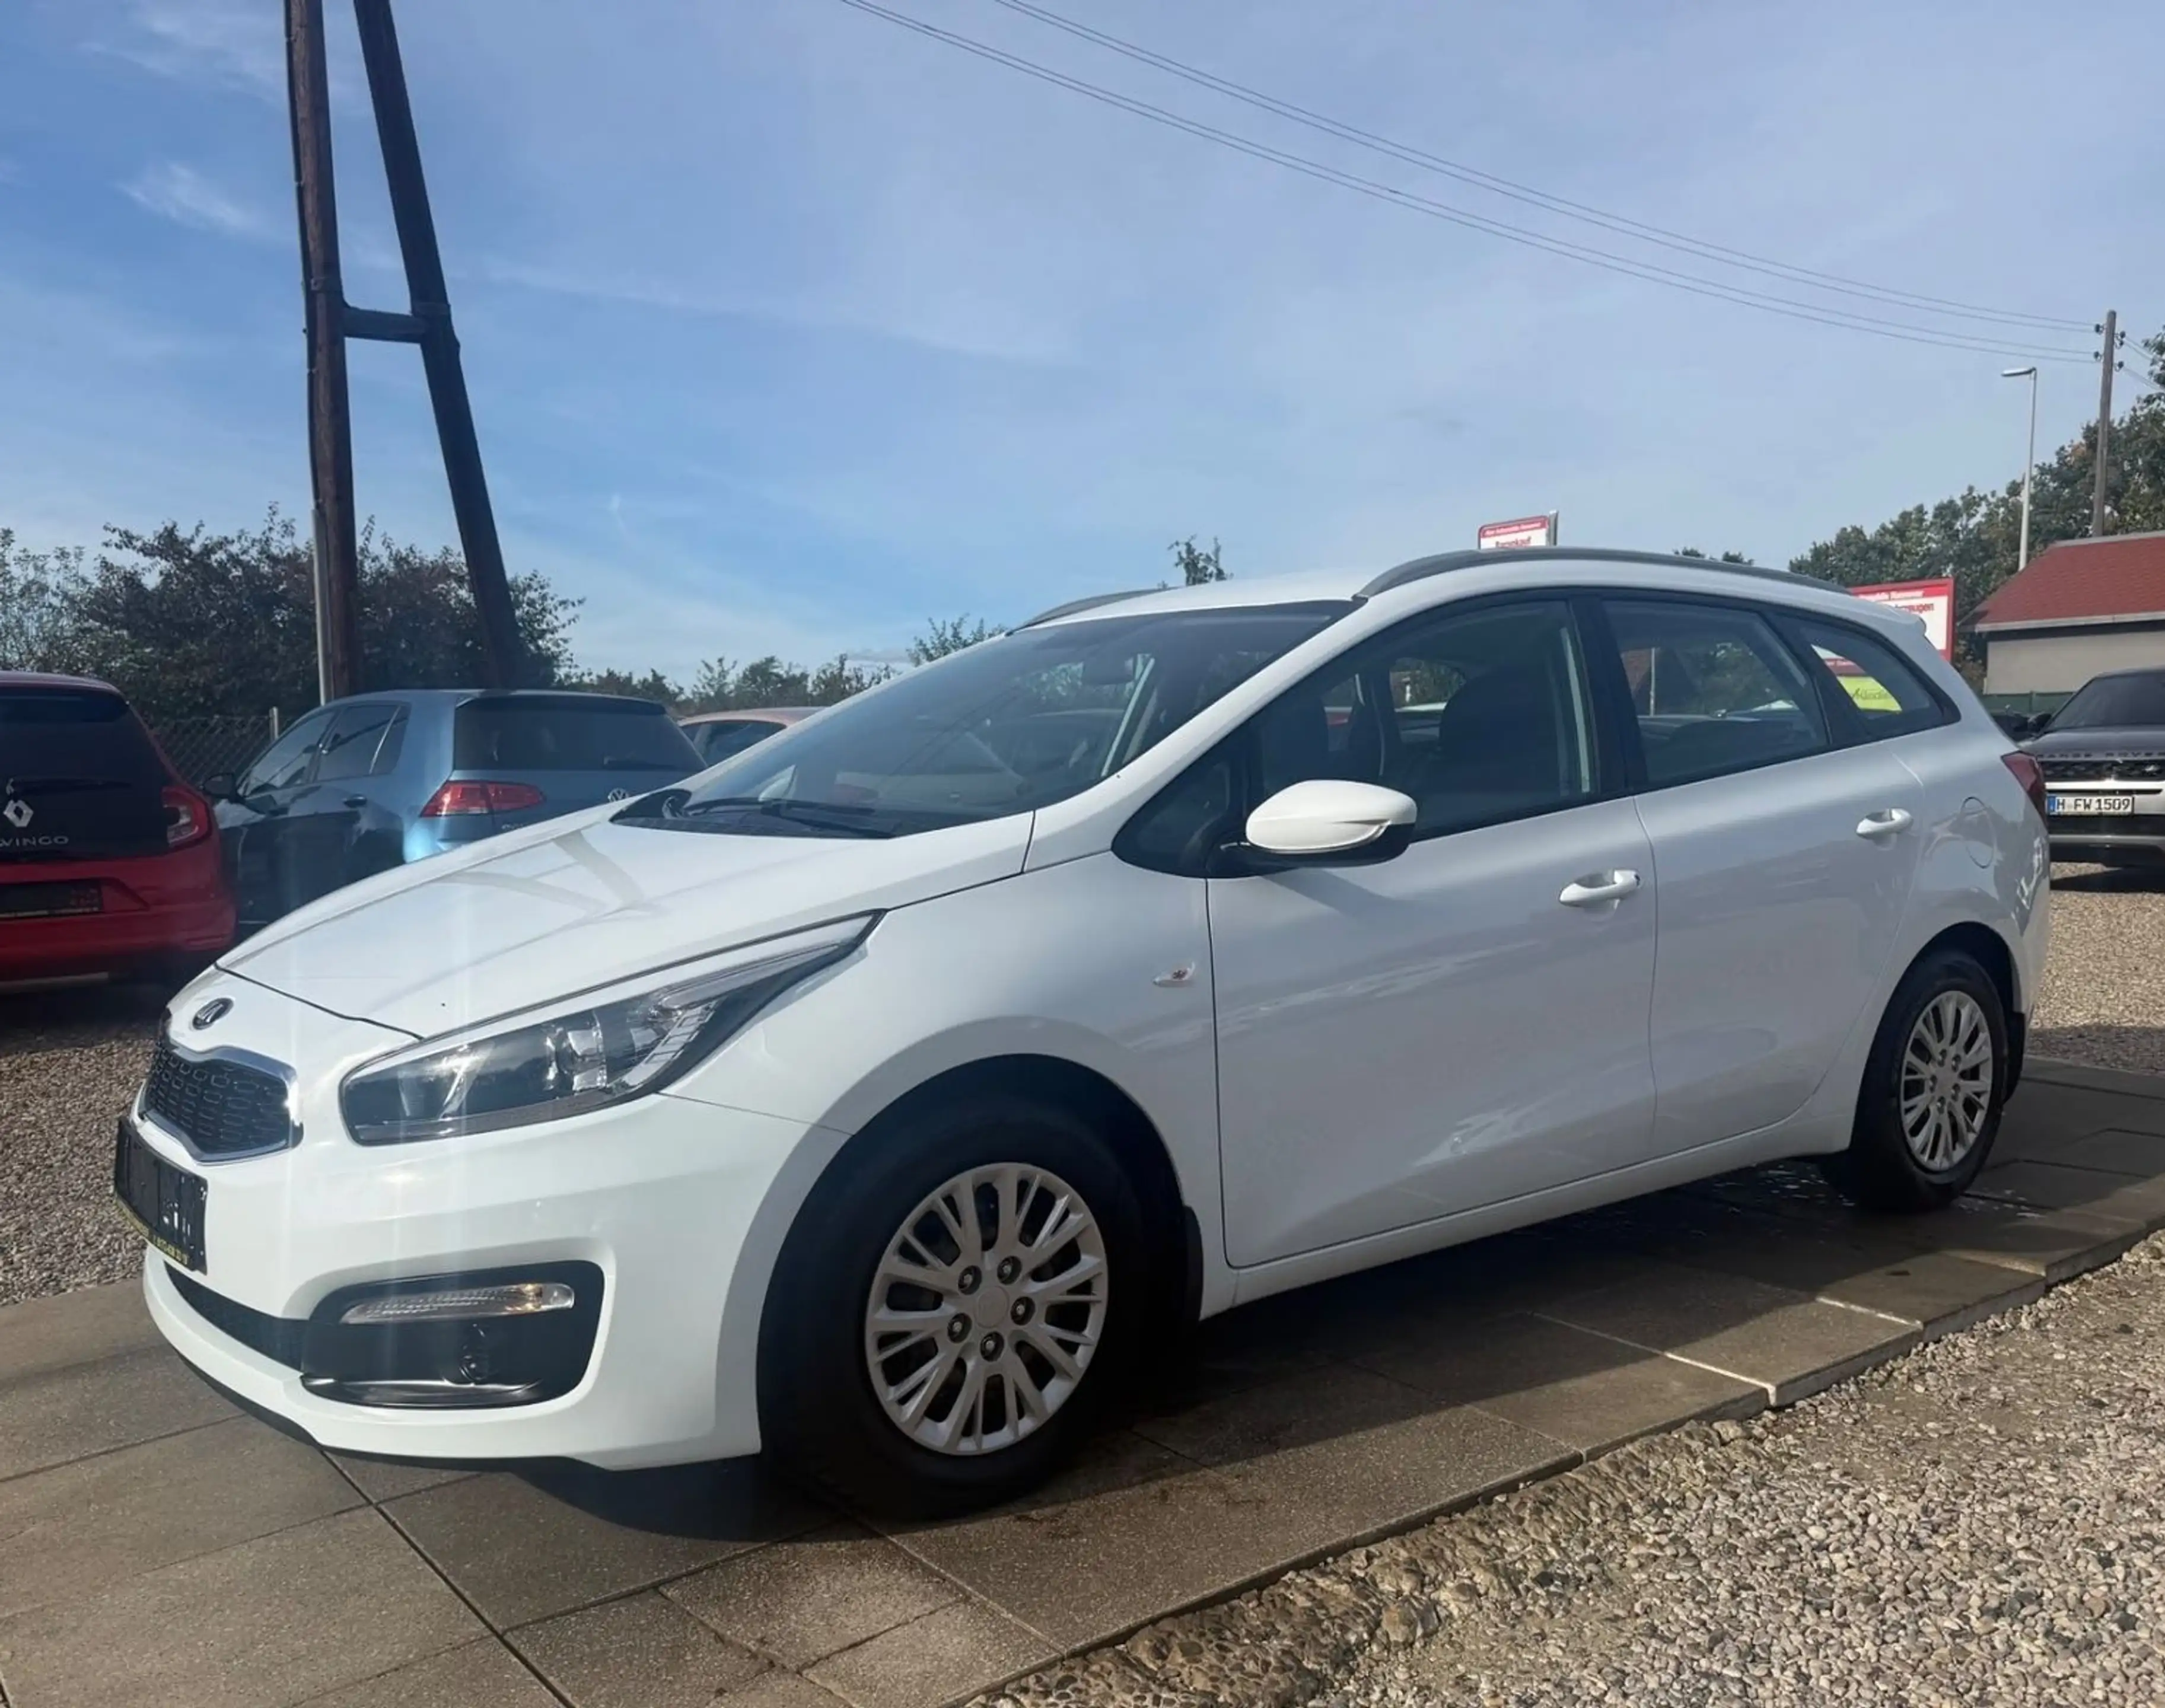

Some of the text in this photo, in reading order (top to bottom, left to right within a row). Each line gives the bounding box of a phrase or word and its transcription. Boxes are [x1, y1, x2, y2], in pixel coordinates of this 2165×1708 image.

[2056, 798, 2131, 811] H FW 1509
